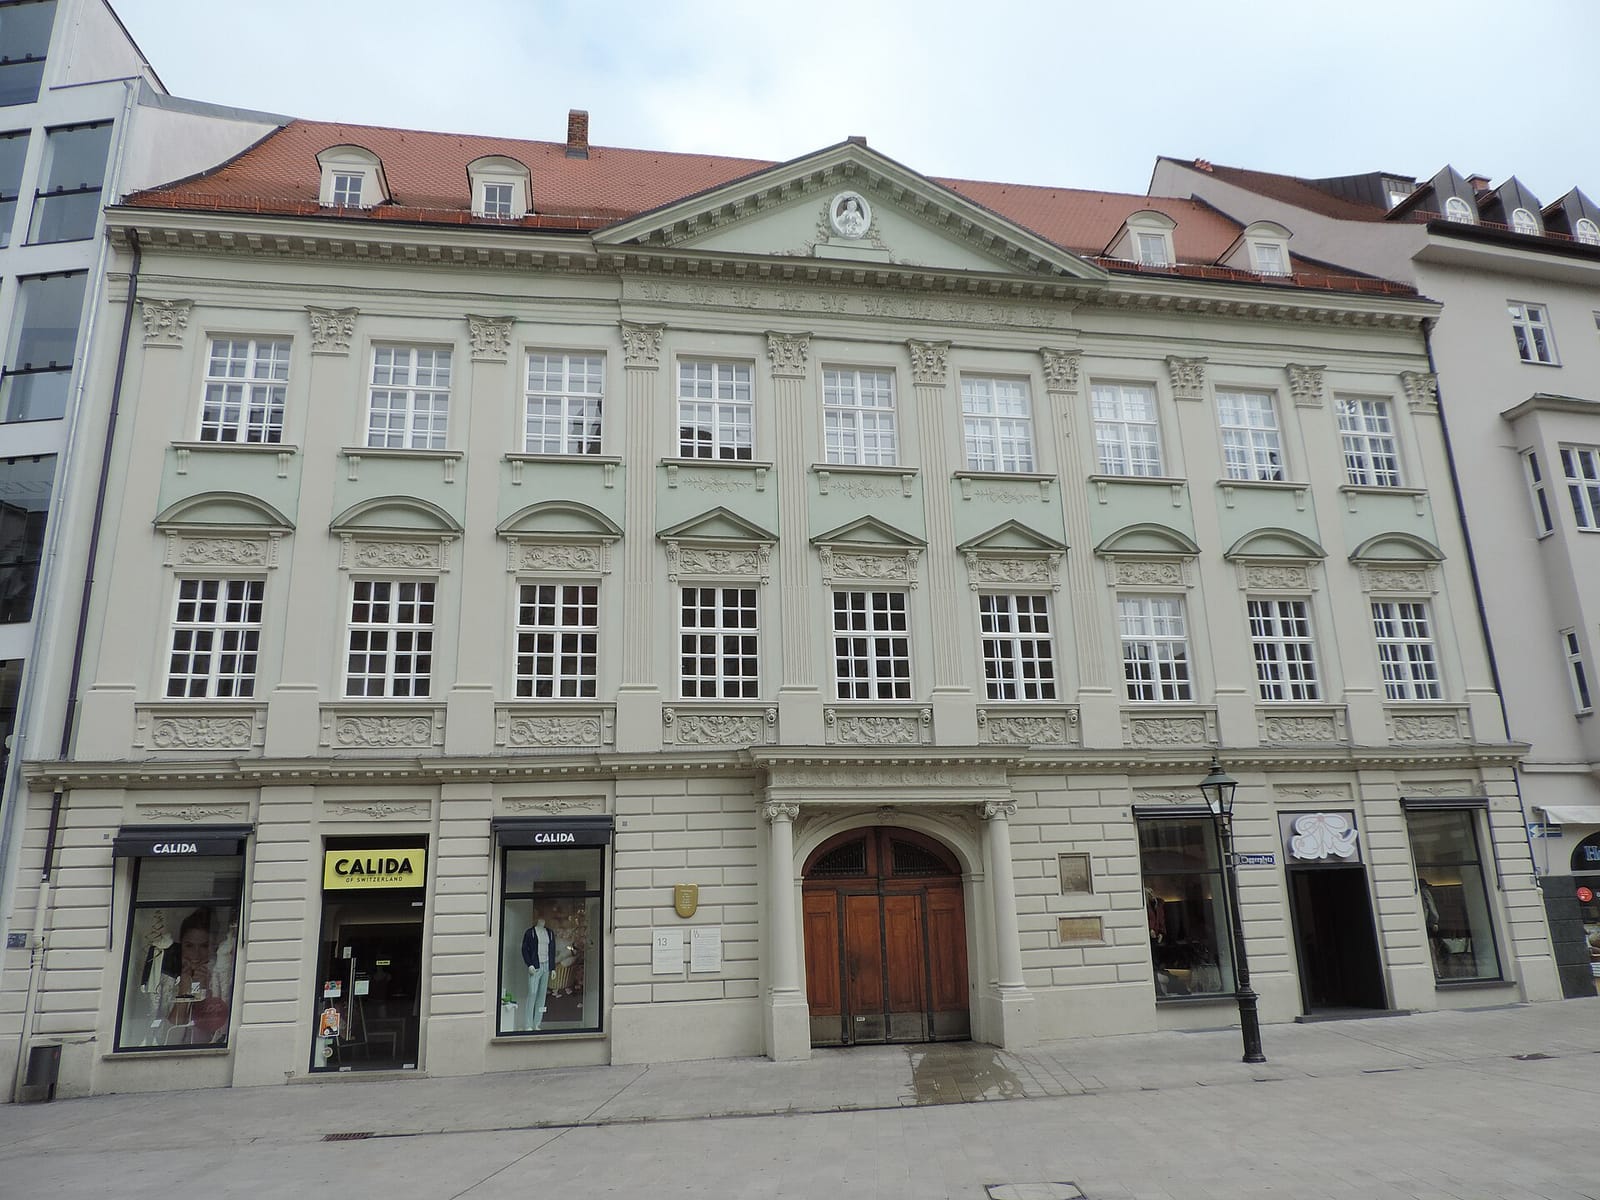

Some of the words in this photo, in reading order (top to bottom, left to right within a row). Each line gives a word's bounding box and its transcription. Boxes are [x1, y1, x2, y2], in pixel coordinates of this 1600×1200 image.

[535, 833, 575, 843] CALIDA
[153, 843, 197, 853] CALIDA
[335, 857, 413, 875] CALIDA
[657, 937, 668, 947] 13
